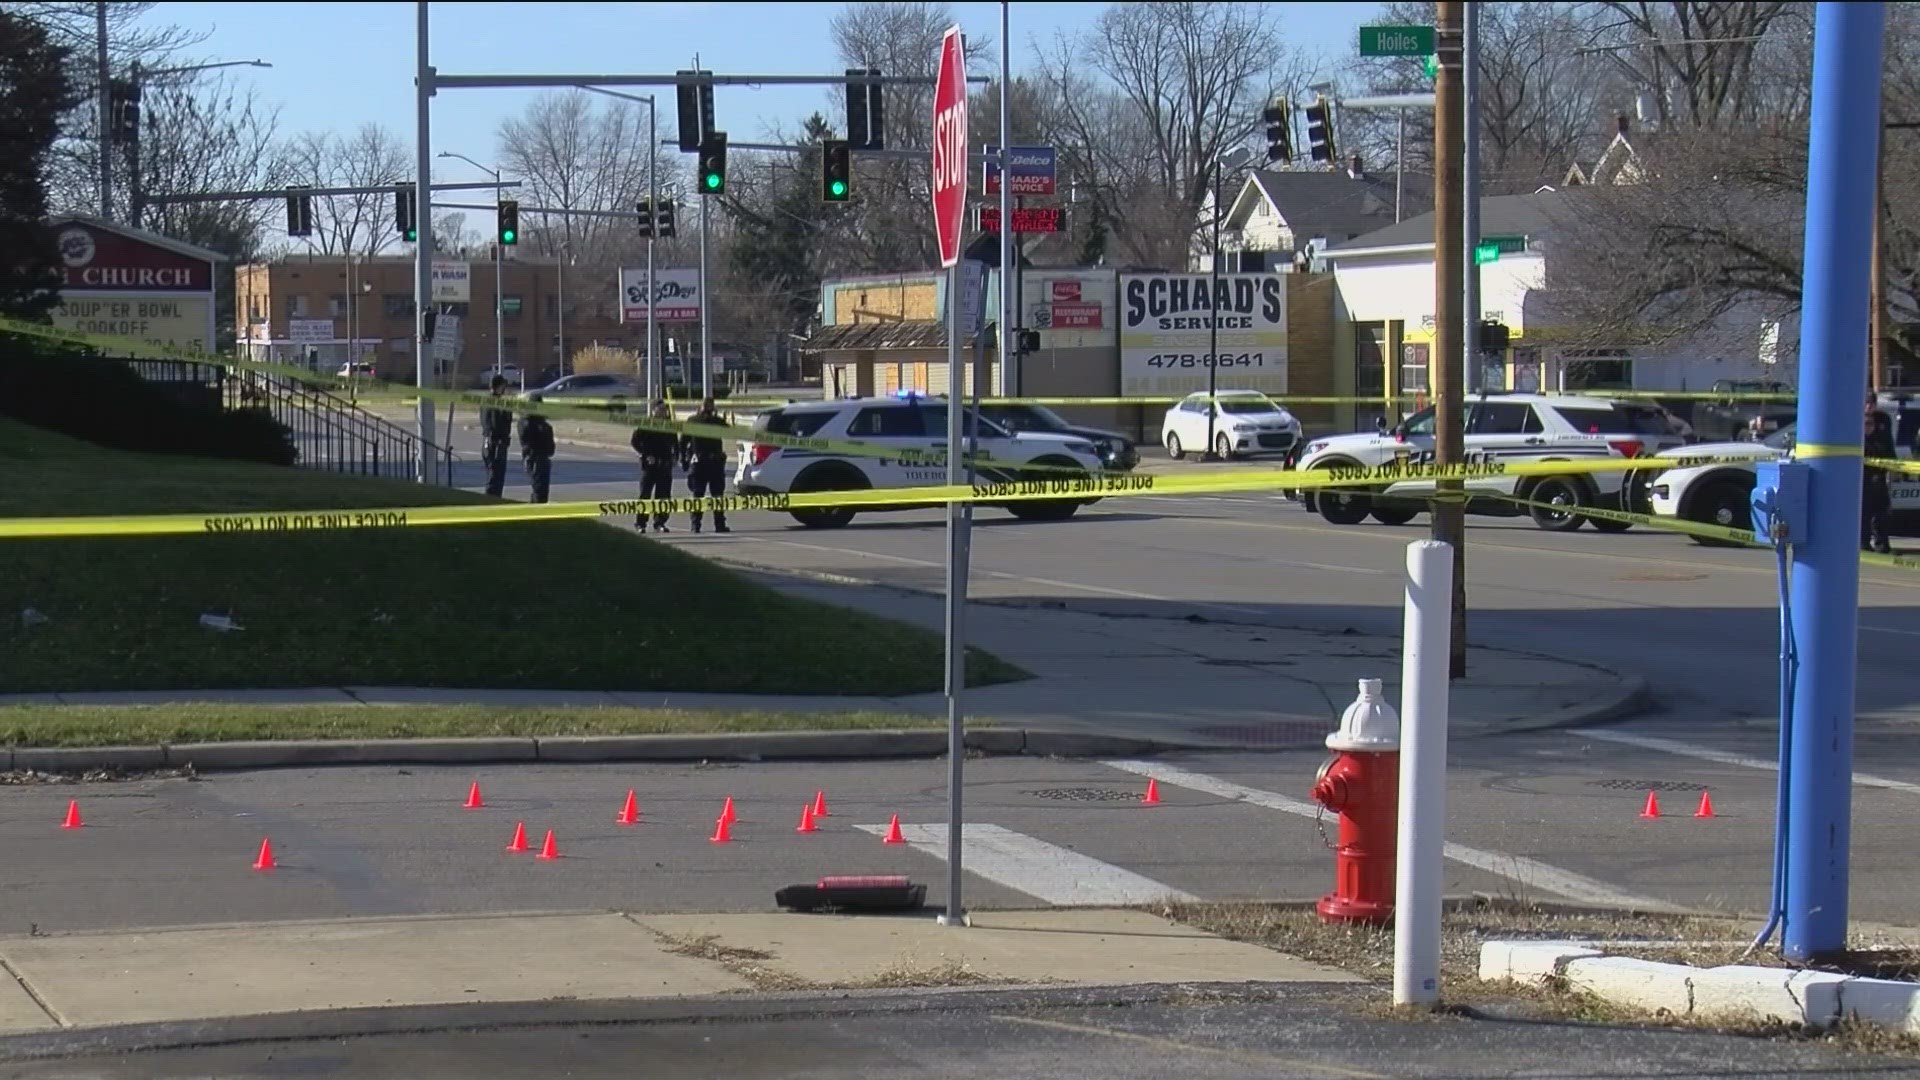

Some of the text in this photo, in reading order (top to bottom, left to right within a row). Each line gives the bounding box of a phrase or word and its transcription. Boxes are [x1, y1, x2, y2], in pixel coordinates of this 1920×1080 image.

[1377, 32, 1418, 50] Hoiles
[936, 100, 964, 192] STOP
[1010, 155, 1050, 165] Delco
[83, 268, 191, 285] CHURCH
[138, 302, 181, 318] BOWL
[1127, 277, 1281, 327] SCHAAD'S
[77, 321, 149, 335] COOKOFF
[1159, 316, 1252, 329] SERVICE
[1147, 353, 1263, 368] 478-6641
[1328, 465, 1372, 481] CROSS
[1374, 464, 1401, 480] NOT
[972, 475, 1153, 498] POLICE LINE DO NOT CROSS
[1892, 488, 1920, 498] EDO
[599, 493, 790, 515] POLICE LINE DO NOT CROSS
[204, 511, 407, 533] POLICE LINE DO NOT CROSS
